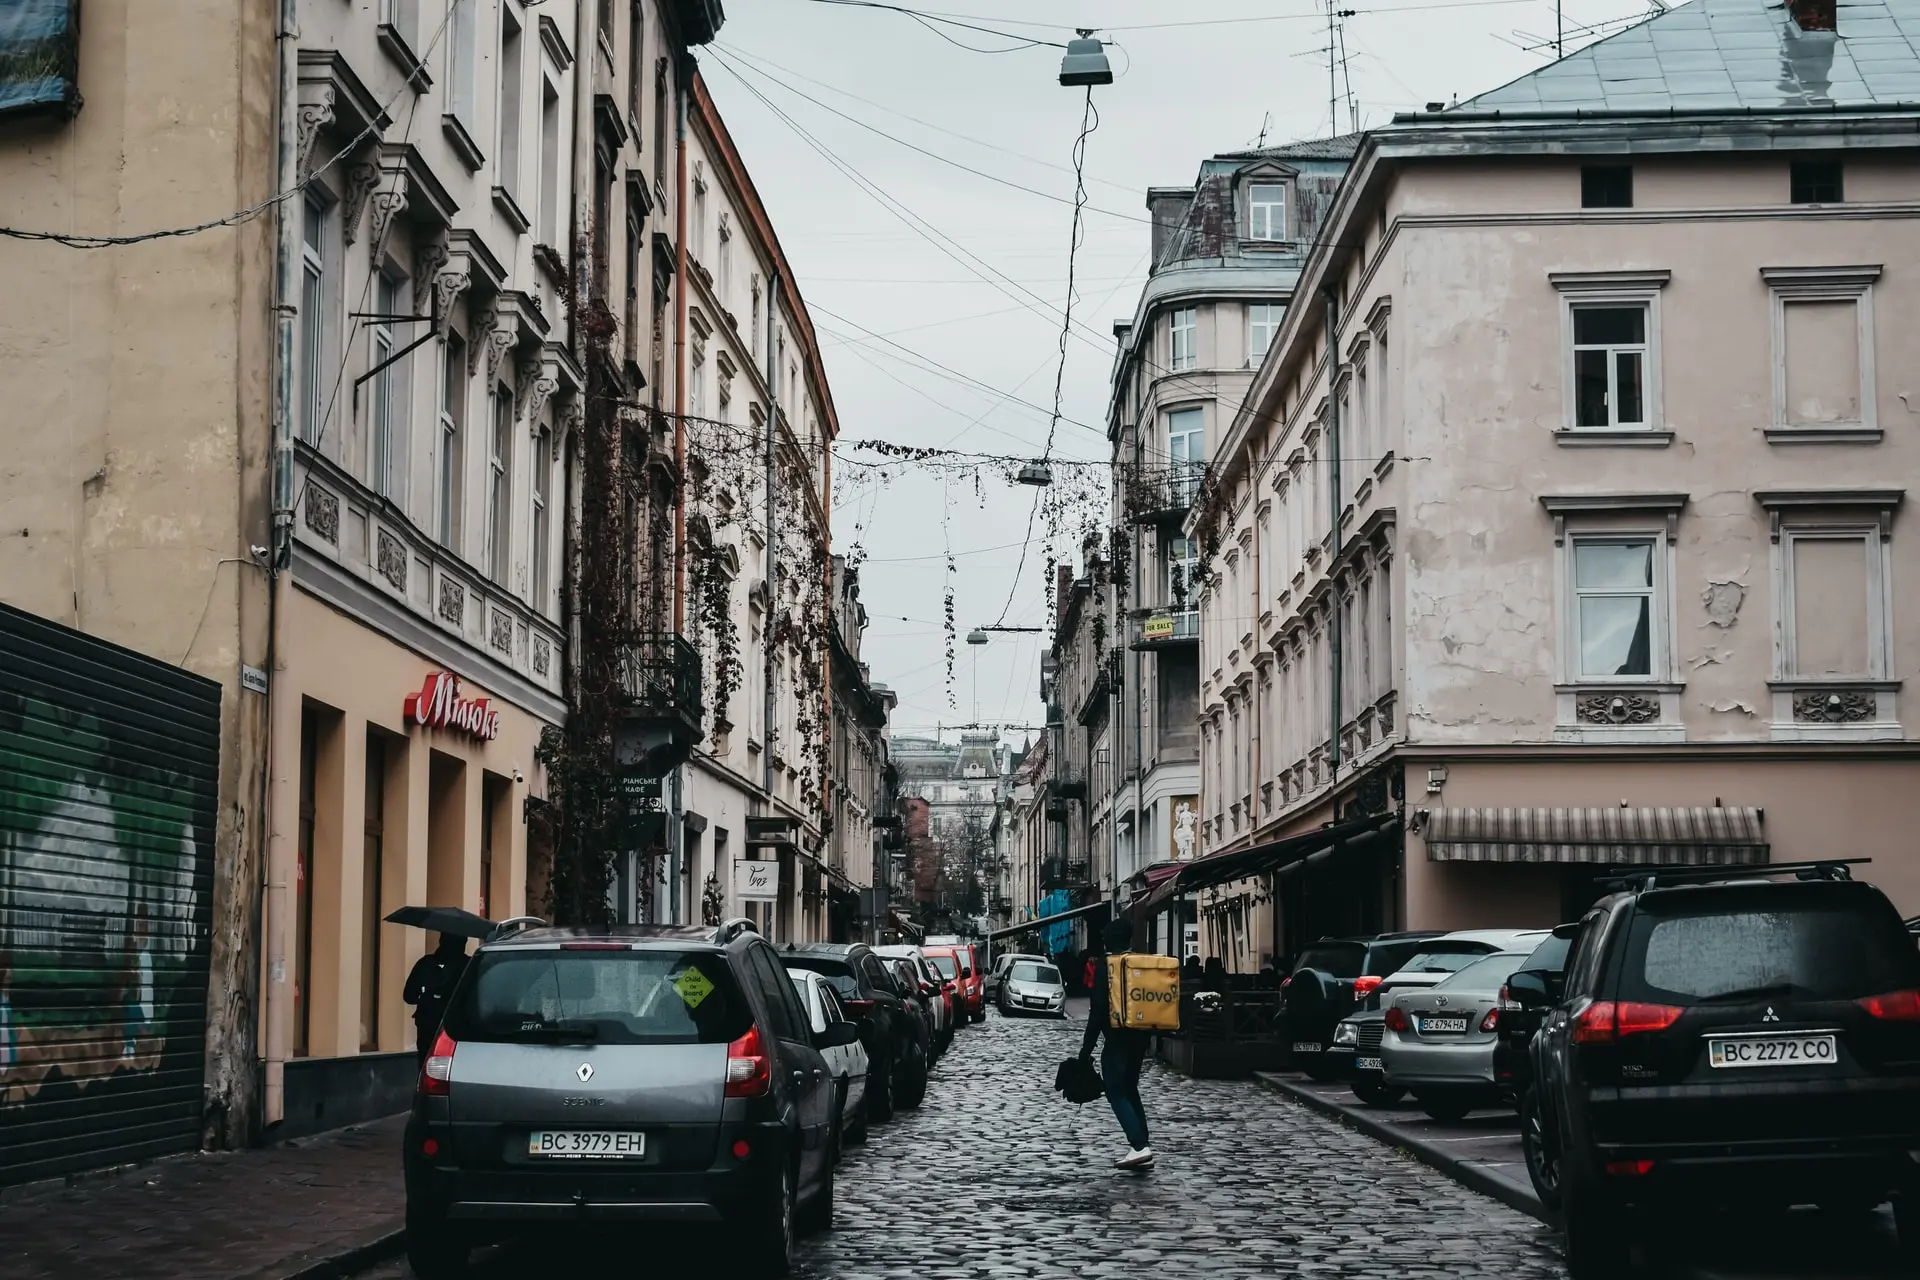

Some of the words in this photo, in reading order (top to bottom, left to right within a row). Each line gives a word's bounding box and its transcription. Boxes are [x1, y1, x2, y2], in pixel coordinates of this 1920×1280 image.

[1156, 622, 1170, 630] SALE
[1130, 987, 1173, 1003] Glovo
[1423, 1020, 1434, 1030] BC
[1435, 1020, 1452, 1030] 6794
[1453, 1020, 1464, 1030] HA
[1723, 1043, 1752, 1062] BC
[1756, 1041, 1799, 1061] 2272
[1359, 1058, 1368, 1068] BC
[563, 1096, 605, 1106] SCENIC
[541, 1133, 568, 1151] BC
[571, 1133, 612, 1151] 3979
[616, 1134, 642, 1152] EH
